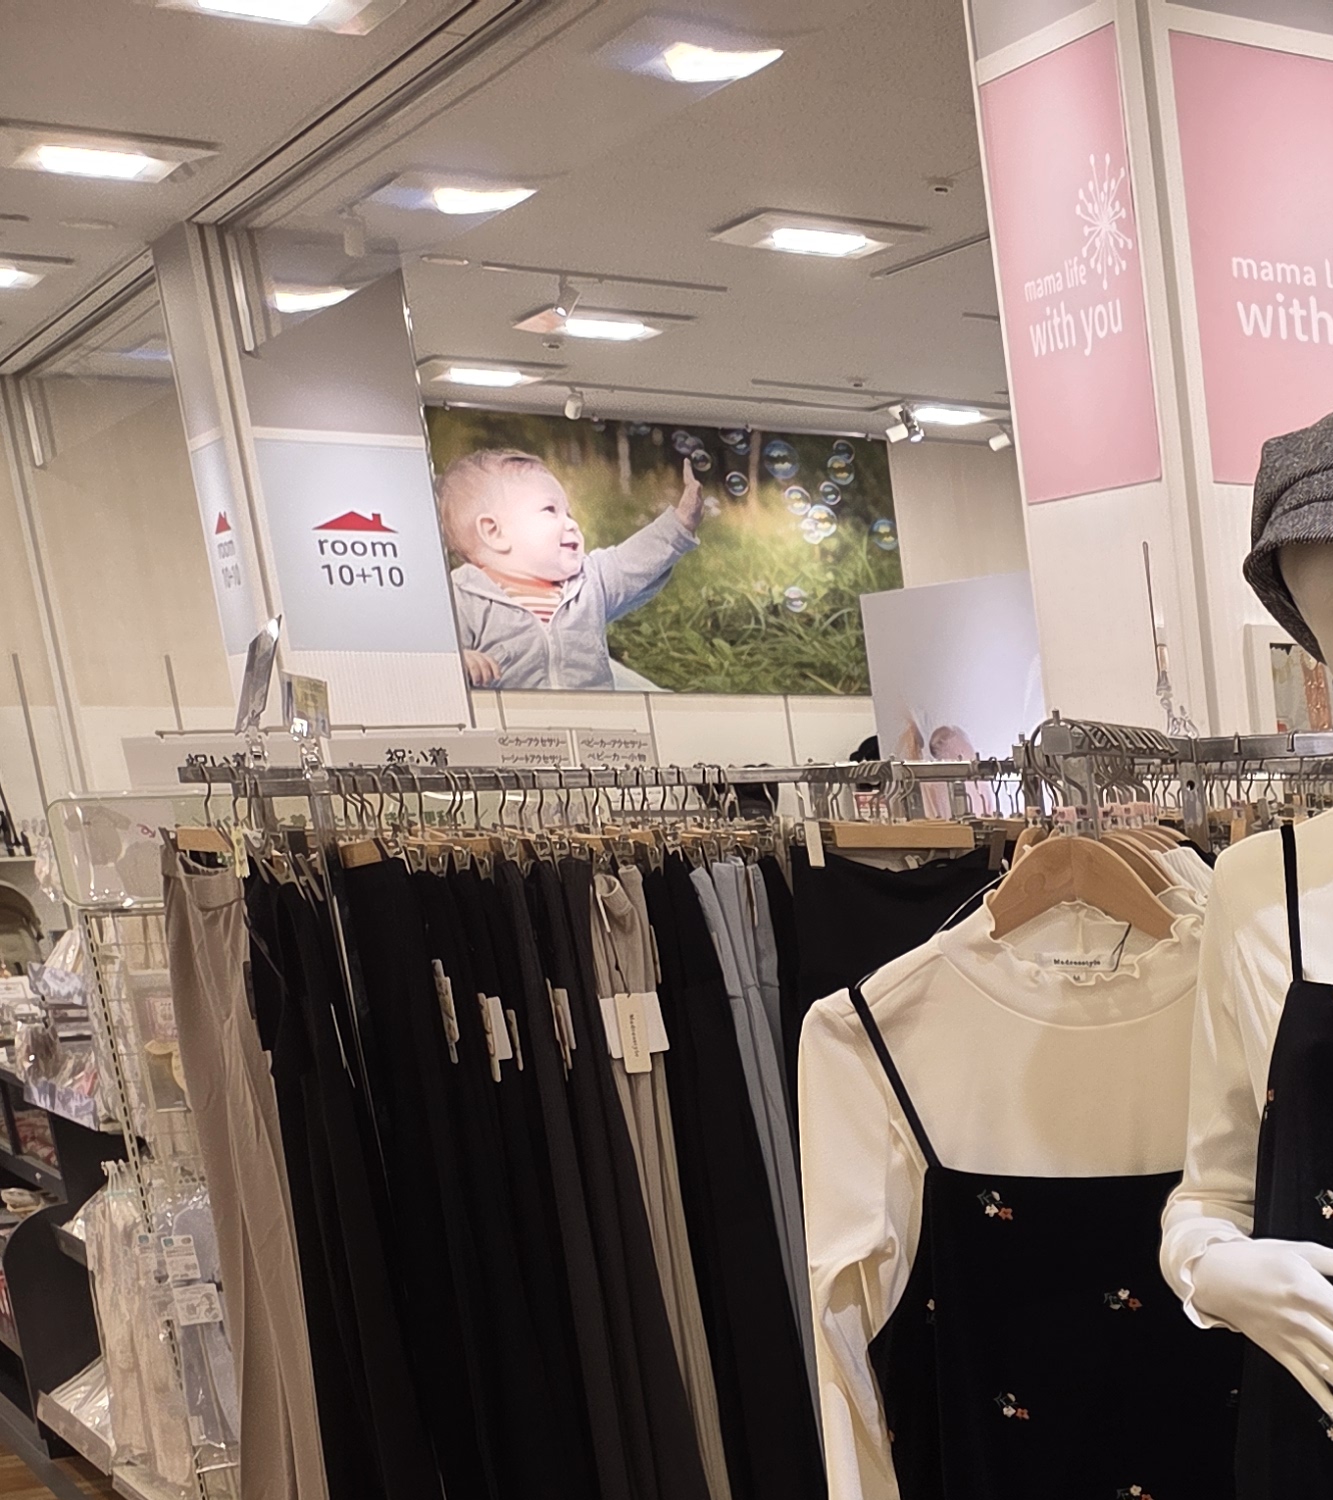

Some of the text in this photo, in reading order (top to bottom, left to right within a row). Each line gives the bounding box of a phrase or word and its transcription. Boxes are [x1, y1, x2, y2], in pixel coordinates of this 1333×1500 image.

[1024, 257, 1087, 302] mama life
[1231, 256, 1317, 287] mama
[1029, 297, 1123, 357] with you
[318, 538, 398, 558] room
[321, 563, 405, 588] 10+10
